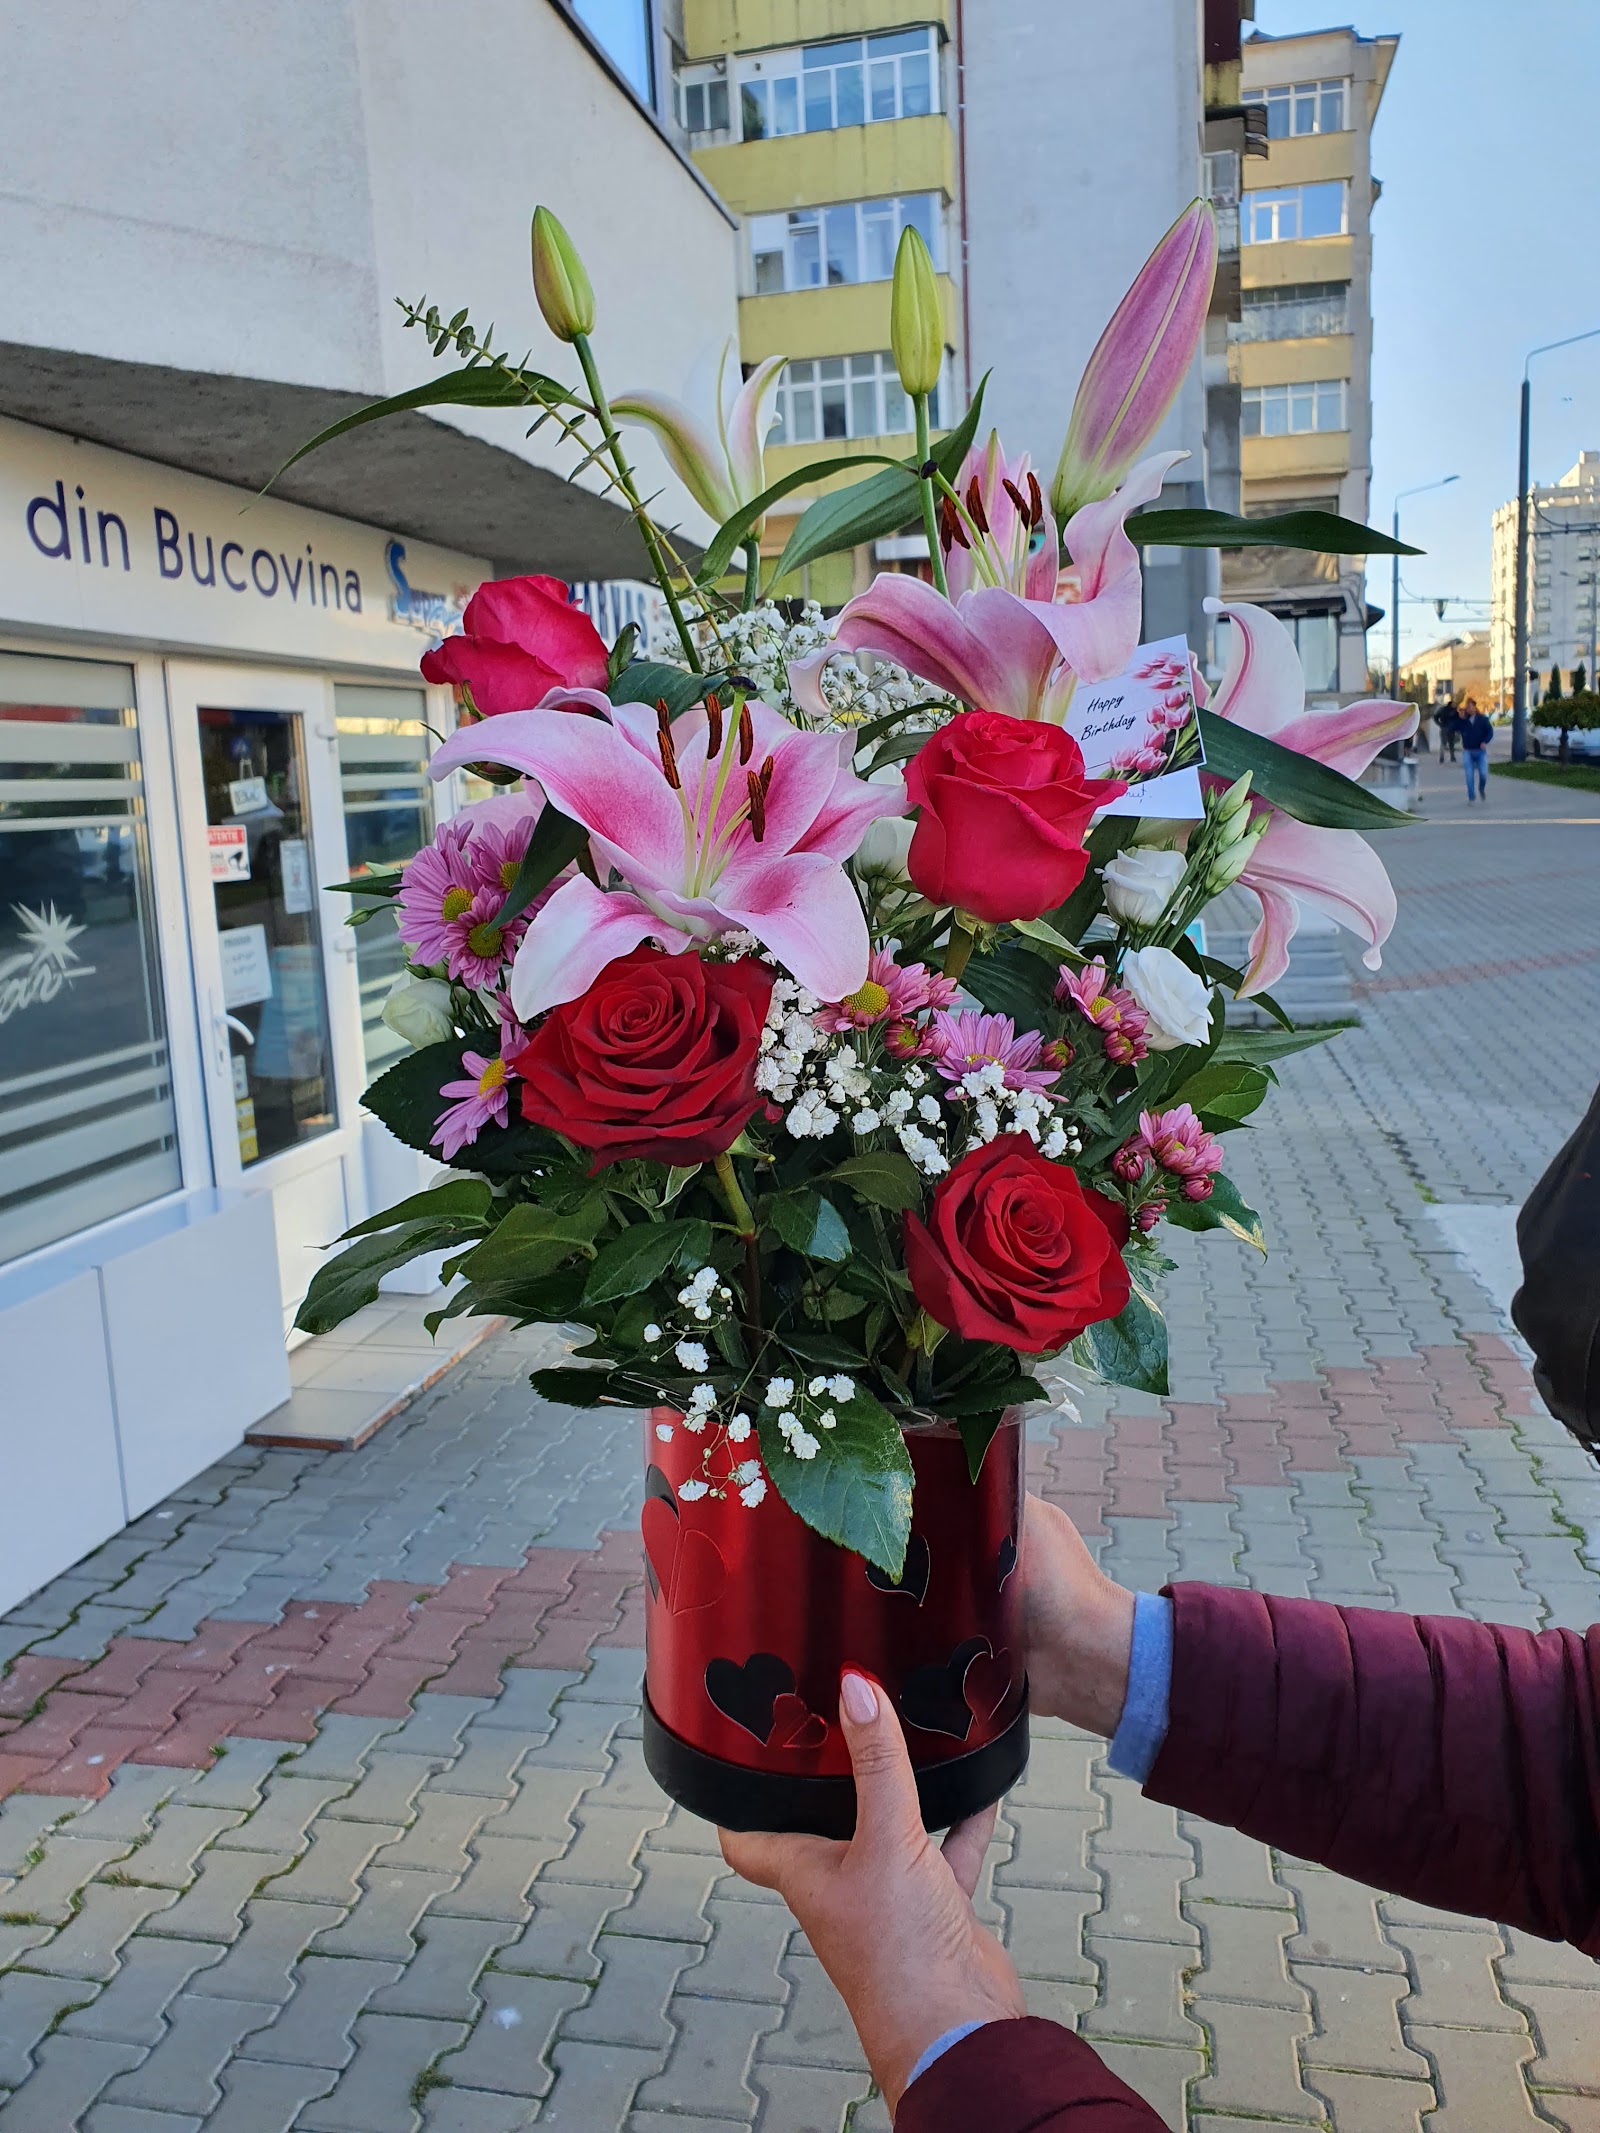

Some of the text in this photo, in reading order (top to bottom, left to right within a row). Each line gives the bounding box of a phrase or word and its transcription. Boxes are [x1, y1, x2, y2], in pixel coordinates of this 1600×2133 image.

[27, 480, 130, 572] din
[154, 507, 362, 613] Bucovina
[1087, 694, 1125, 714] Happy
[1080, 715, 1136, 741] Birthday
